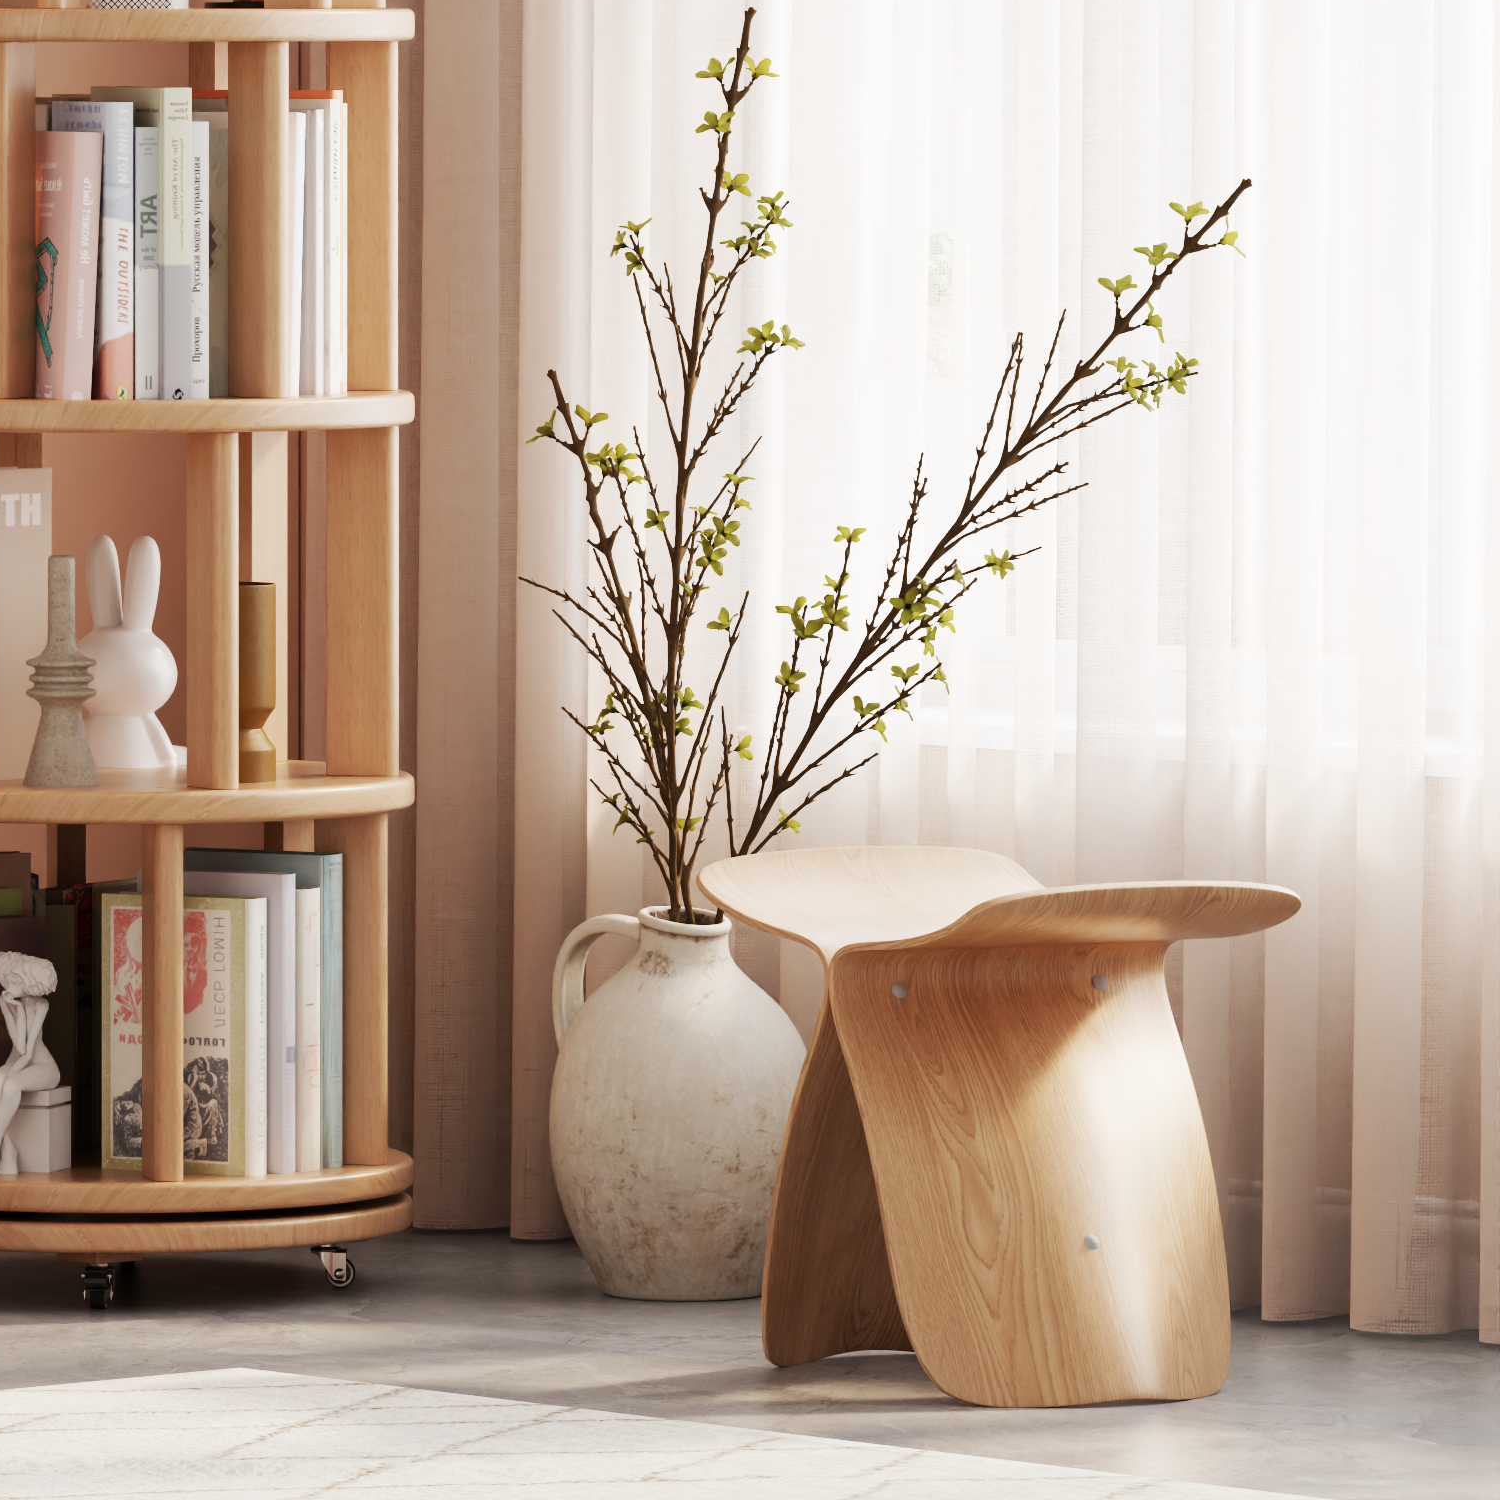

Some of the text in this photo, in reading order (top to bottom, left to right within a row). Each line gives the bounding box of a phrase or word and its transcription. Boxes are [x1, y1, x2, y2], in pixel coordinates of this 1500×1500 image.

[117, 128, 130, 184] HINTON
[192, 156, 202, 293] Русская модель управления
[116, 227, 130, 326] THE OUTSIDERS
[192, 317, 202, 363] Прохоров
